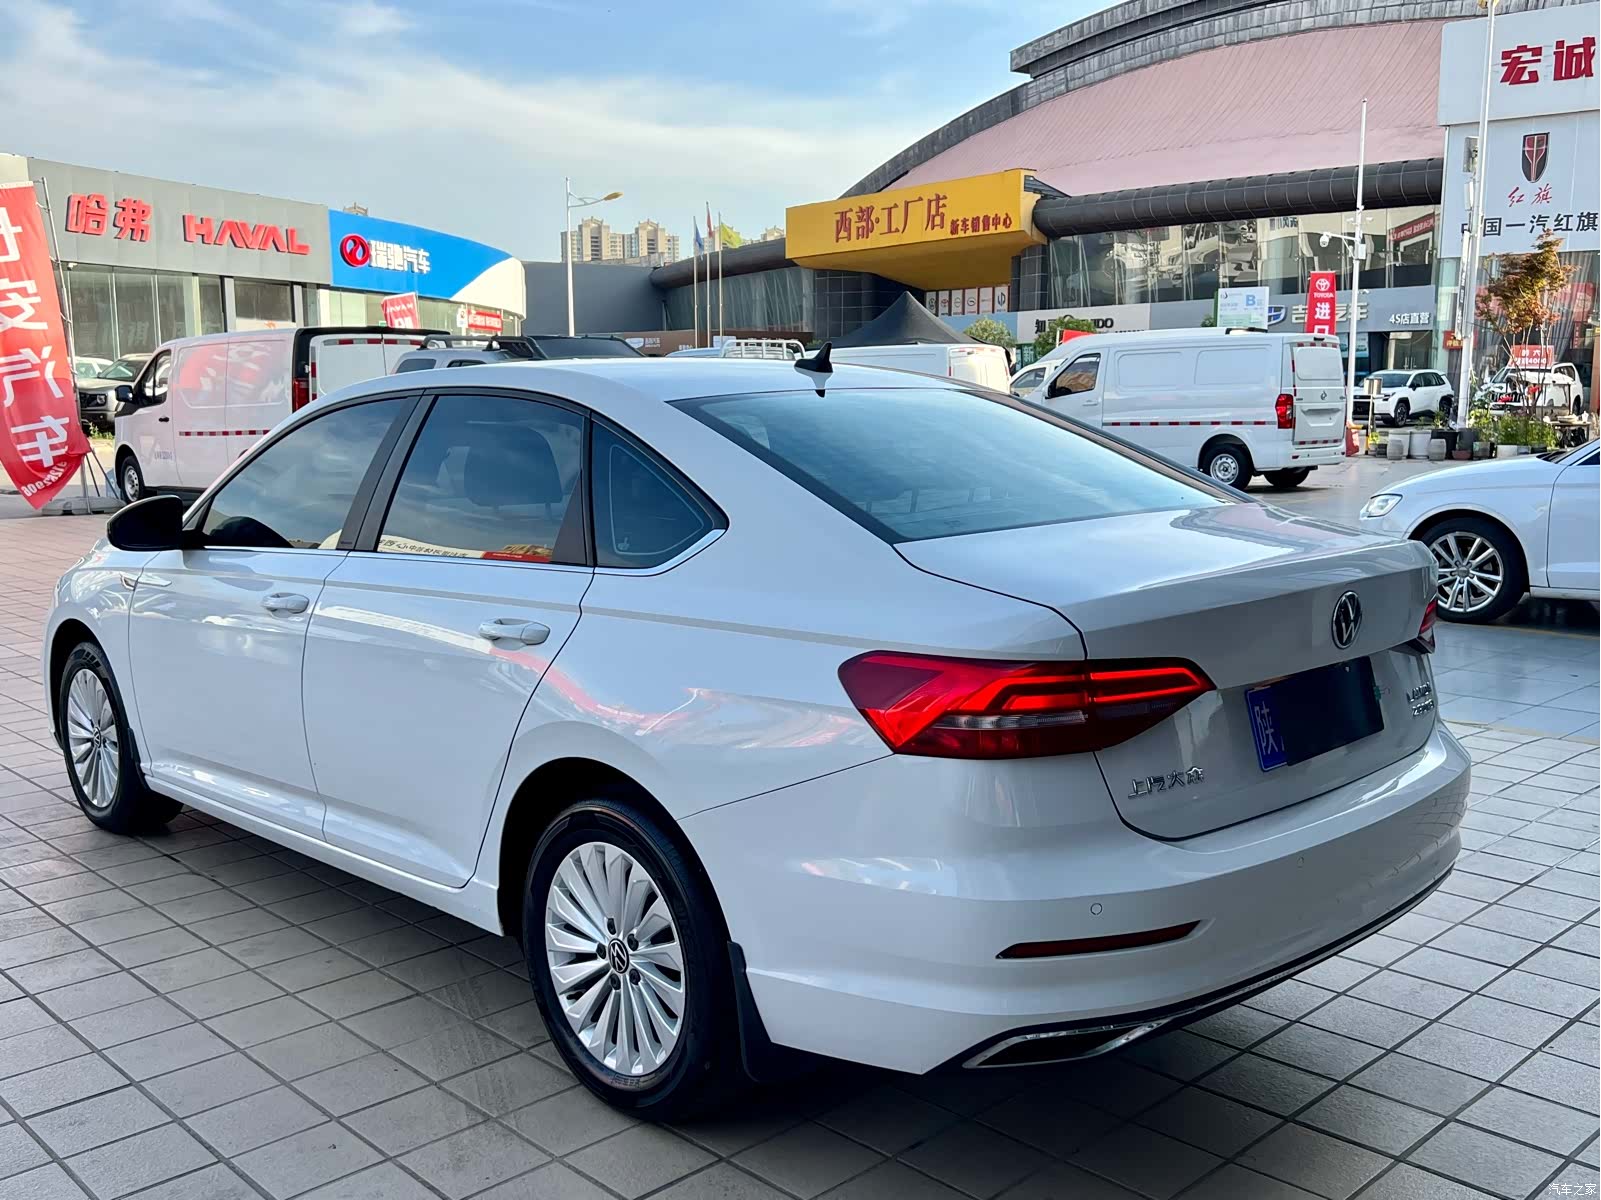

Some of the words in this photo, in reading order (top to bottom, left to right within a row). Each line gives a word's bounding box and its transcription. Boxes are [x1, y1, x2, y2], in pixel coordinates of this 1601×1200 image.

[1500, 36, 1596, 86] 宏诚
[66, 192, 153, 243] 哈弗
[183, 213, 311, 256] HAVAL
[950, 212, 1013, 236] 新车销售中心
[368, 240, 431, 274] 瑞驰汽车
[1245, 294, 1256, 306] B
[1389, 312, 1430, 325] 4S店直营
